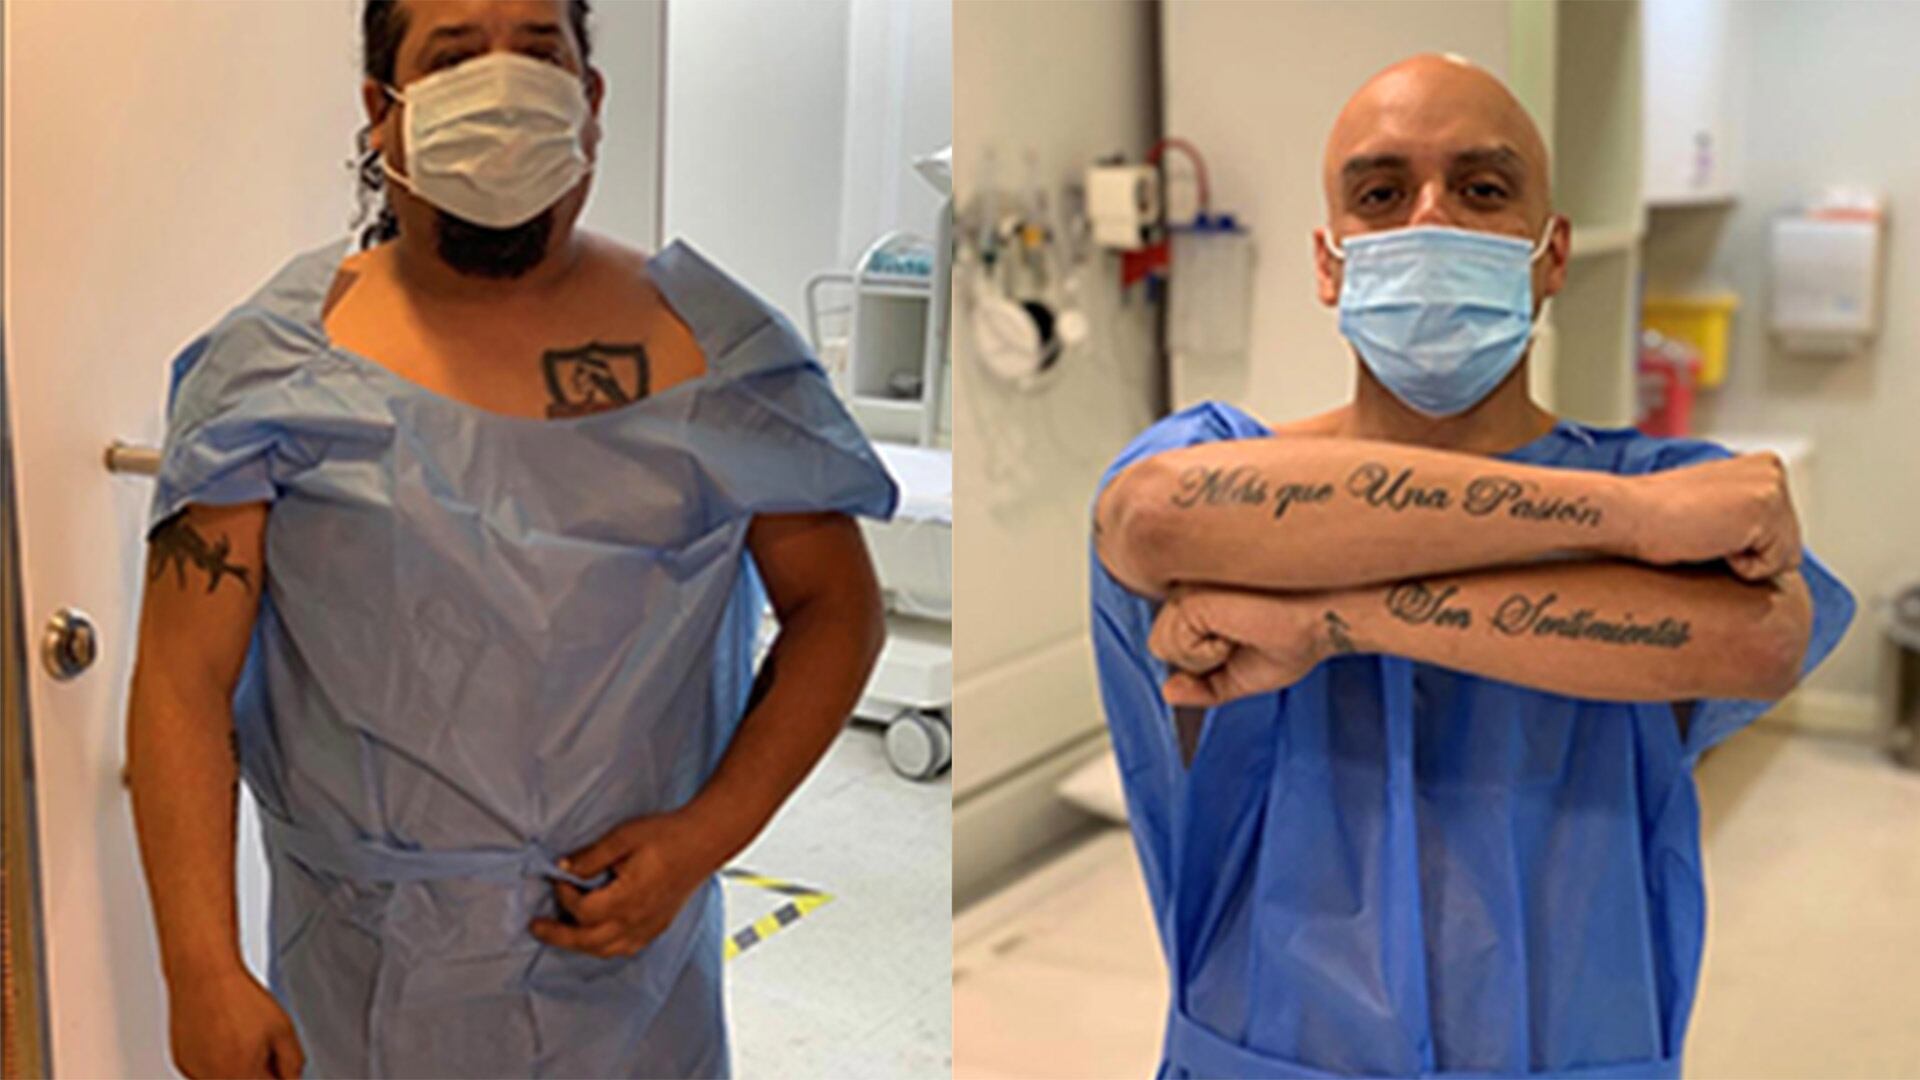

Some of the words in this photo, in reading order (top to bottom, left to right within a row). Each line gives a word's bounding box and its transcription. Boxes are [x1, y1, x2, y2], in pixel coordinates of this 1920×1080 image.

[1274, 482, 1334, 520] que
[1346, 462, 1450, 511] Una
[1463, 475, 1602, 527] Pasión
